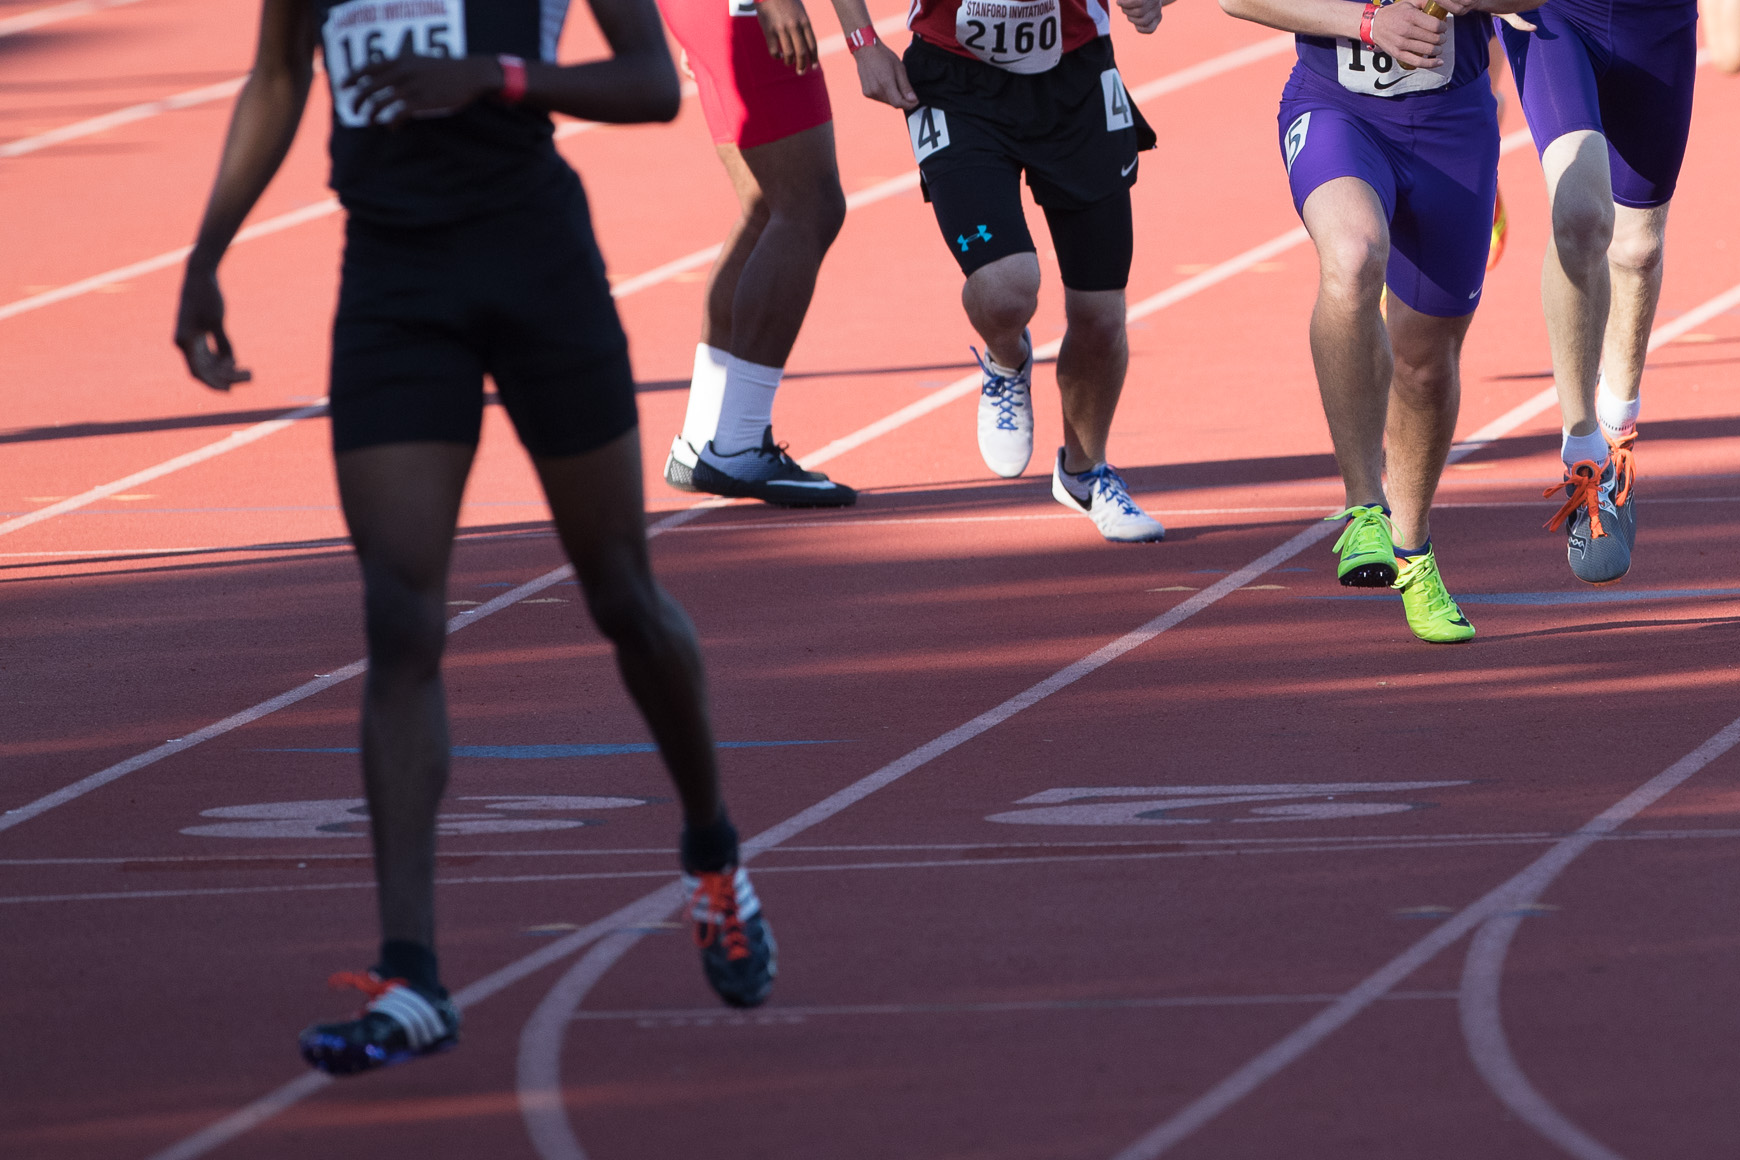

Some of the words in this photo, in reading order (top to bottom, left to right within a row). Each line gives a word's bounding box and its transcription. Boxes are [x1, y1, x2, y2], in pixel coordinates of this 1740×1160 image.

[966, 1, 1007, 18] STANFORD
[1009, 1, 1056, 18] INVITATIONAL
[965, 16, 1057, 54] 2160
[1110, 73, 1129, 124] 4
[918, 107, 941, 150] 4
